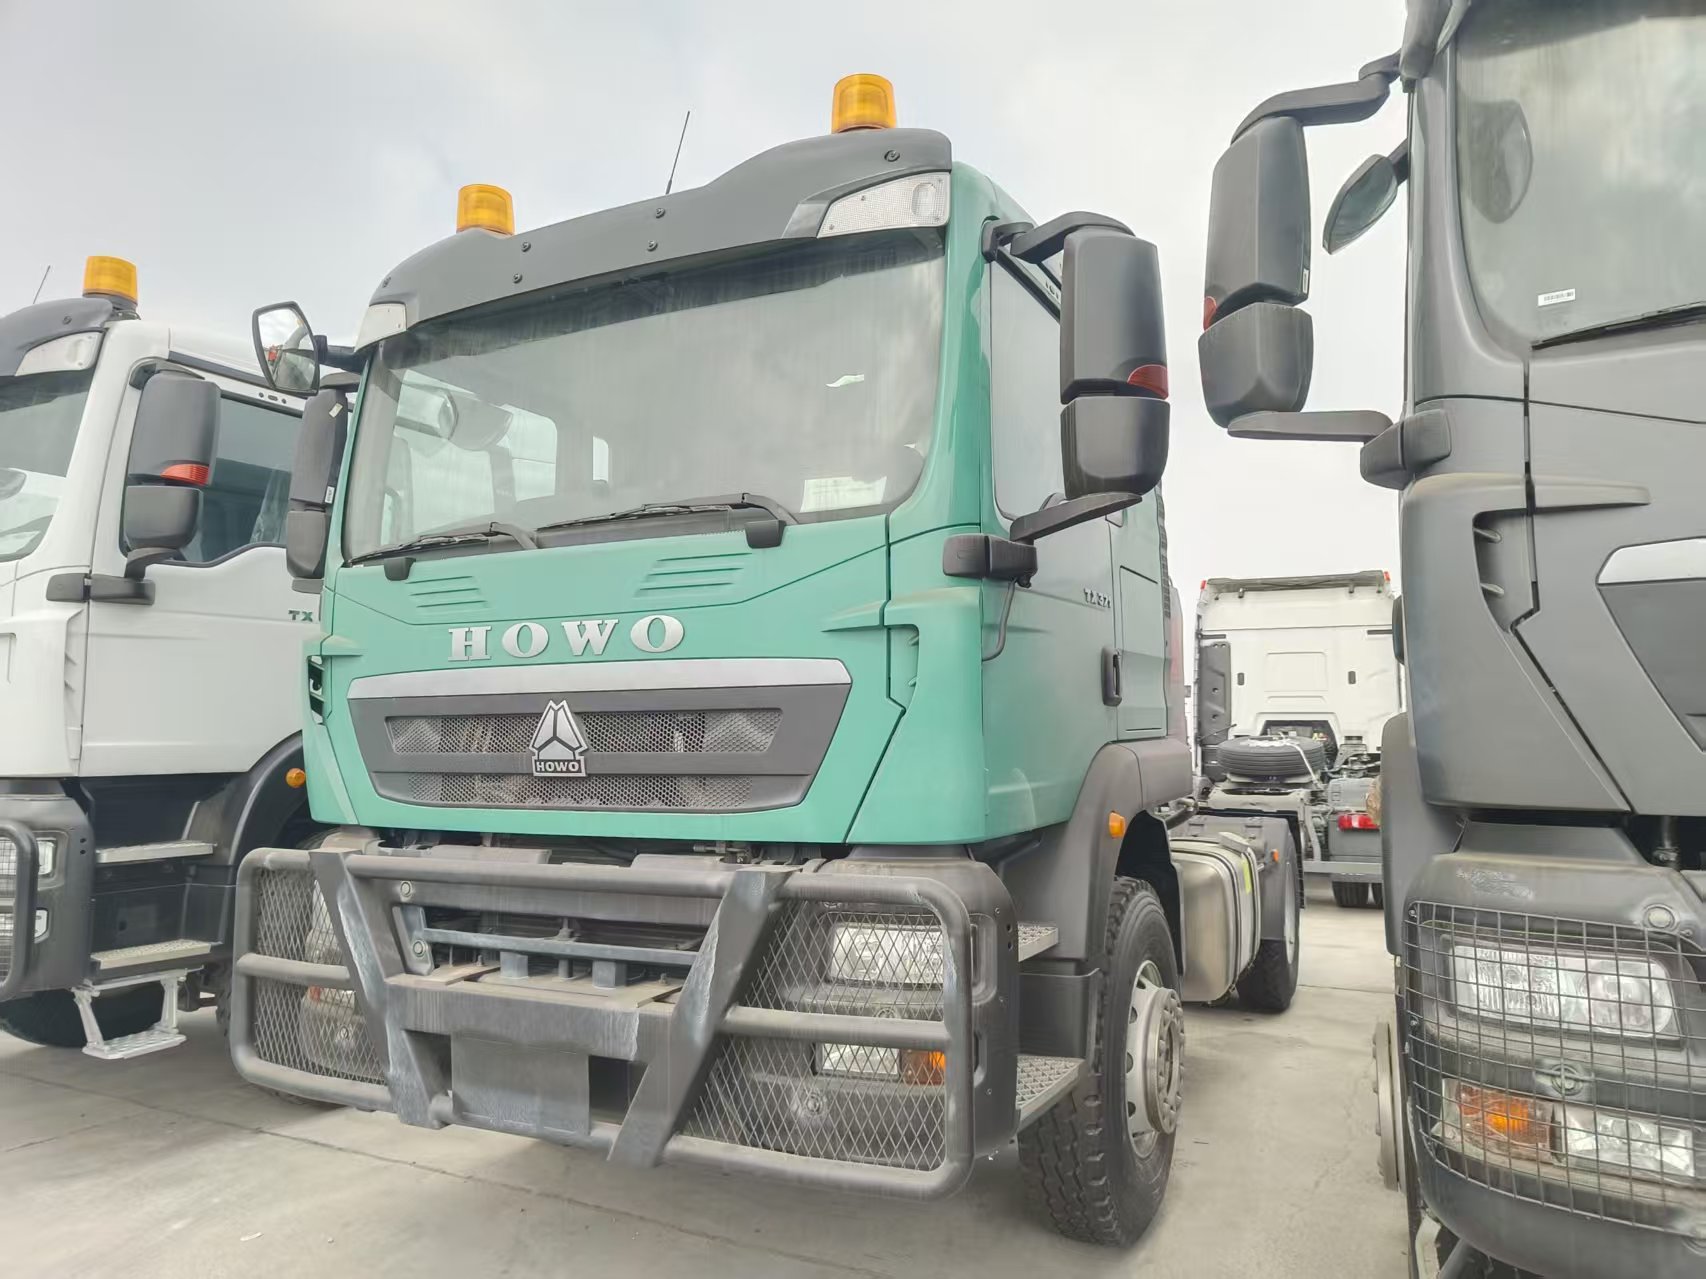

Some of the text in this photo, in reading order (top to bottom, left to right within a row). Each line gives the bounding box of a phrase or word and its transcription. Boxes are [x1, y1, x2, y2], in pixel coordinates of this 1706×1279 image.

[288, 609, 313, 622] TX
[448, 614, 685, 662] HOWO
[536, 761, 580, 772] HOWO
